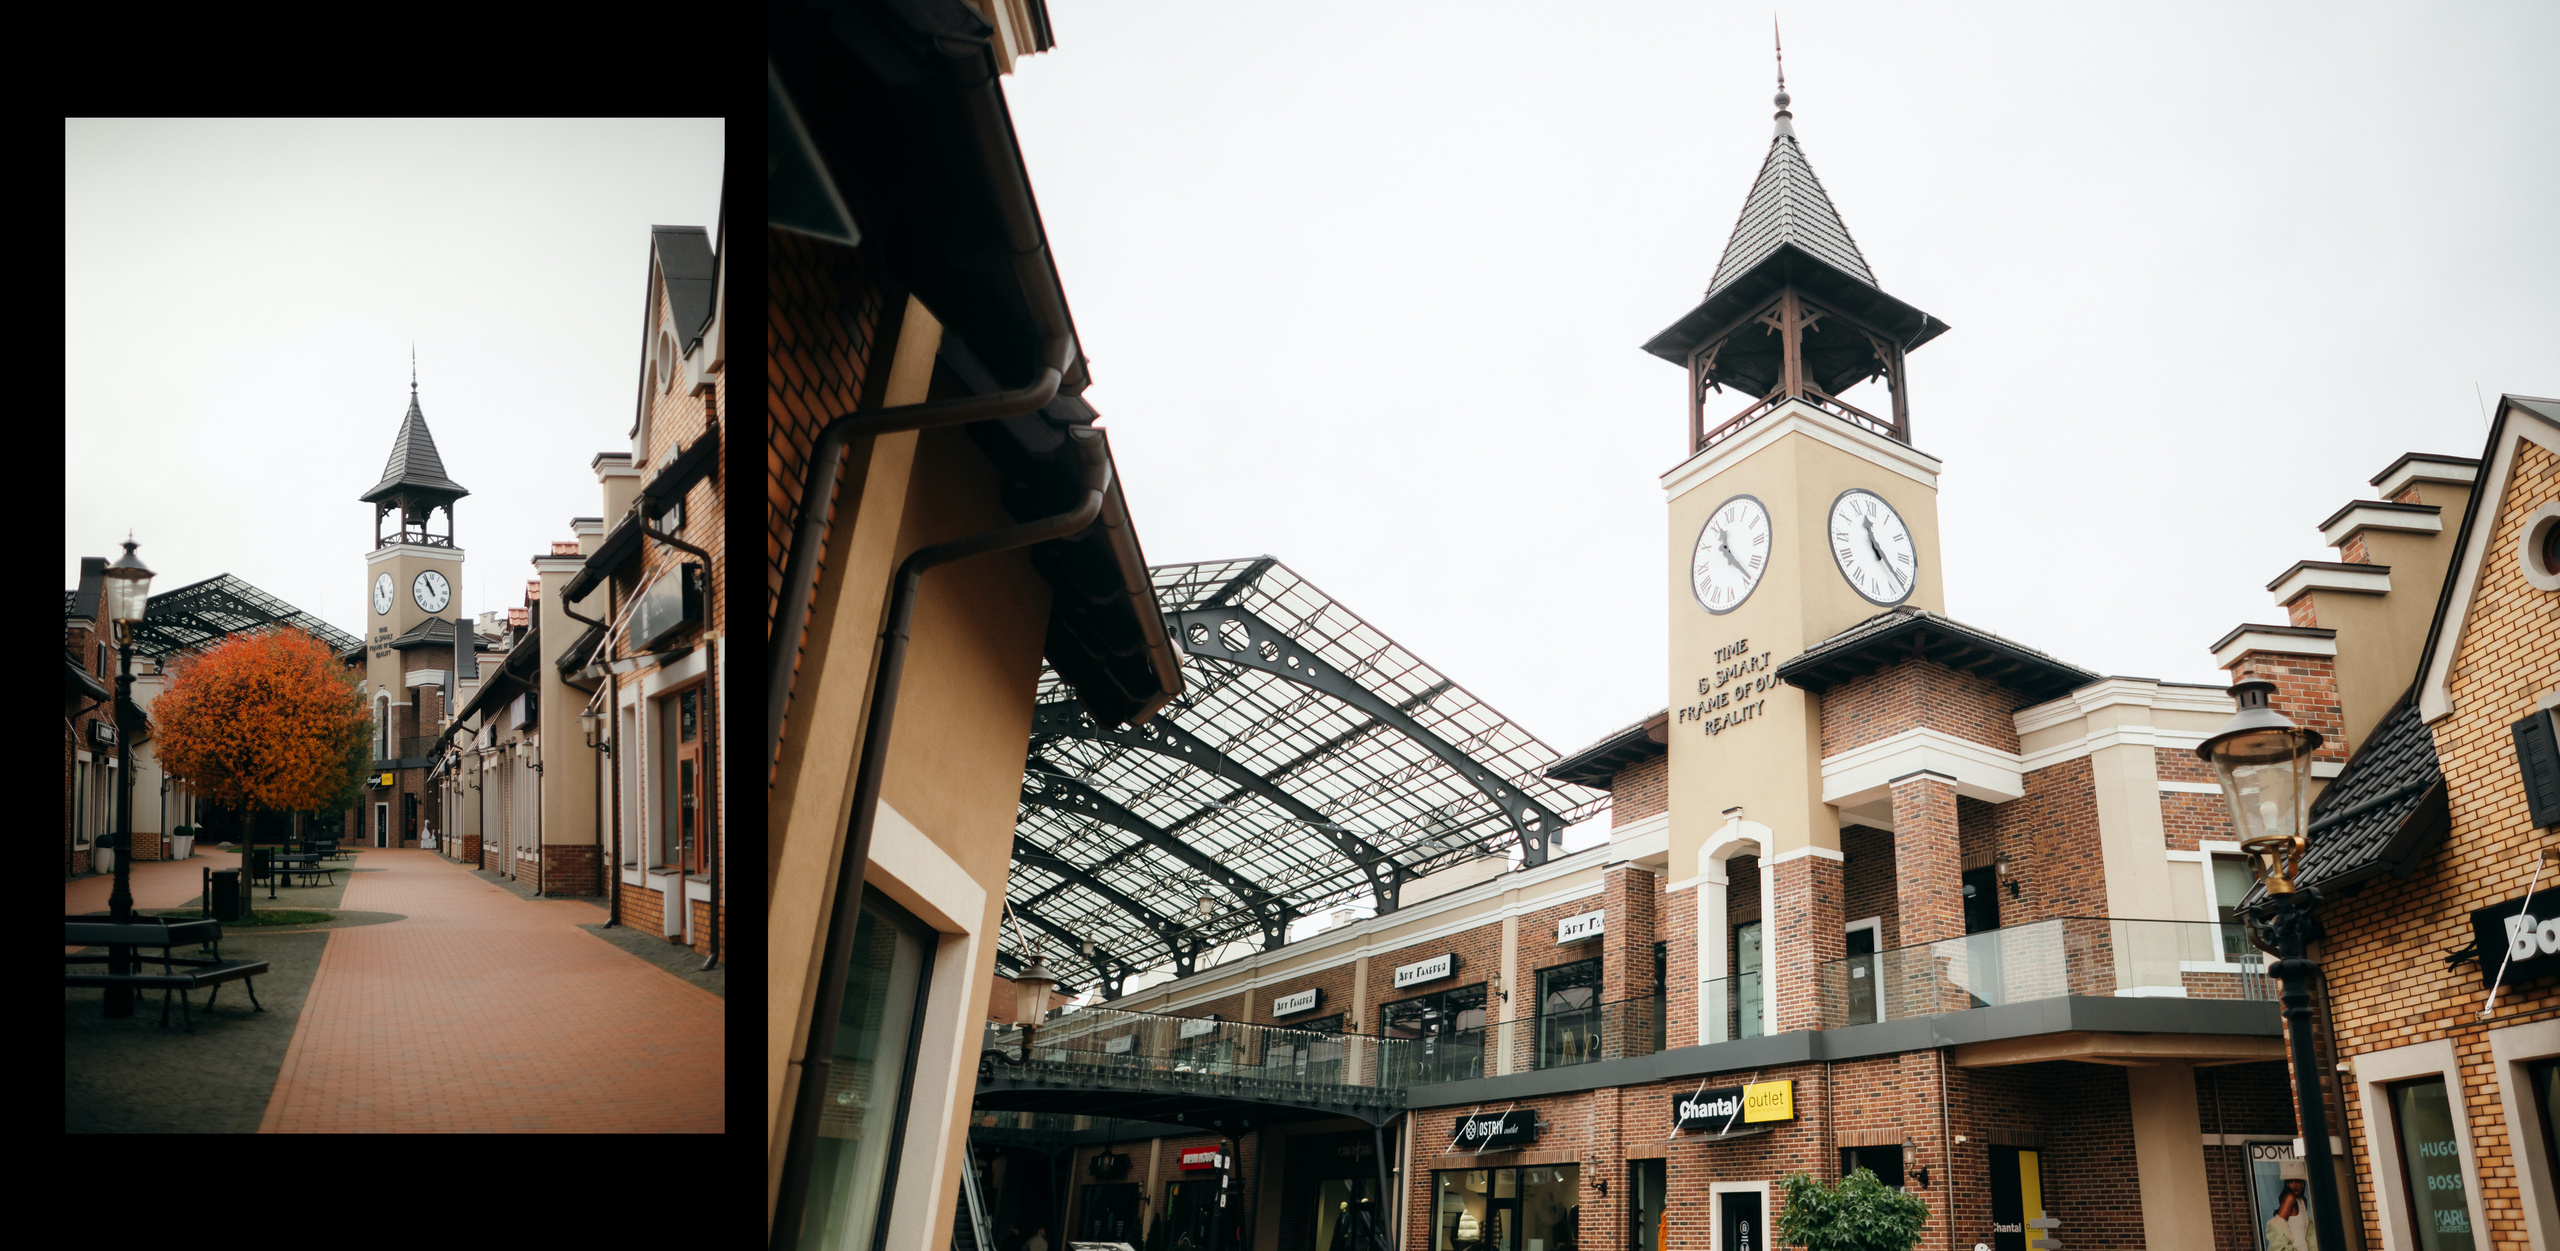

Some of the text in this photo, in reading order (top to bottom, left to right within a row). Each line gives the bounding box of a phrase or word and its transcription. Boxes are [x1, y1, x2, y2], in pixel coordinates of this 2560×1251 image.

[1714, 638, 1748, 664] TIME
[1698, 651, 1770, 694] IS SMART
[1678, 692, 1729, 724] FRAME
[1734, 682, 1753, 700] OF
[1705, 700, 1764, 735] REALITY
[1680, 1091, 1784, 1119] Chantal outlet
[2420, 1140, 2458, 1157] HUGO
[2428, 1174, 2462, 1190] BOSS
[2434, 1210, 2468, 1226] KARL
